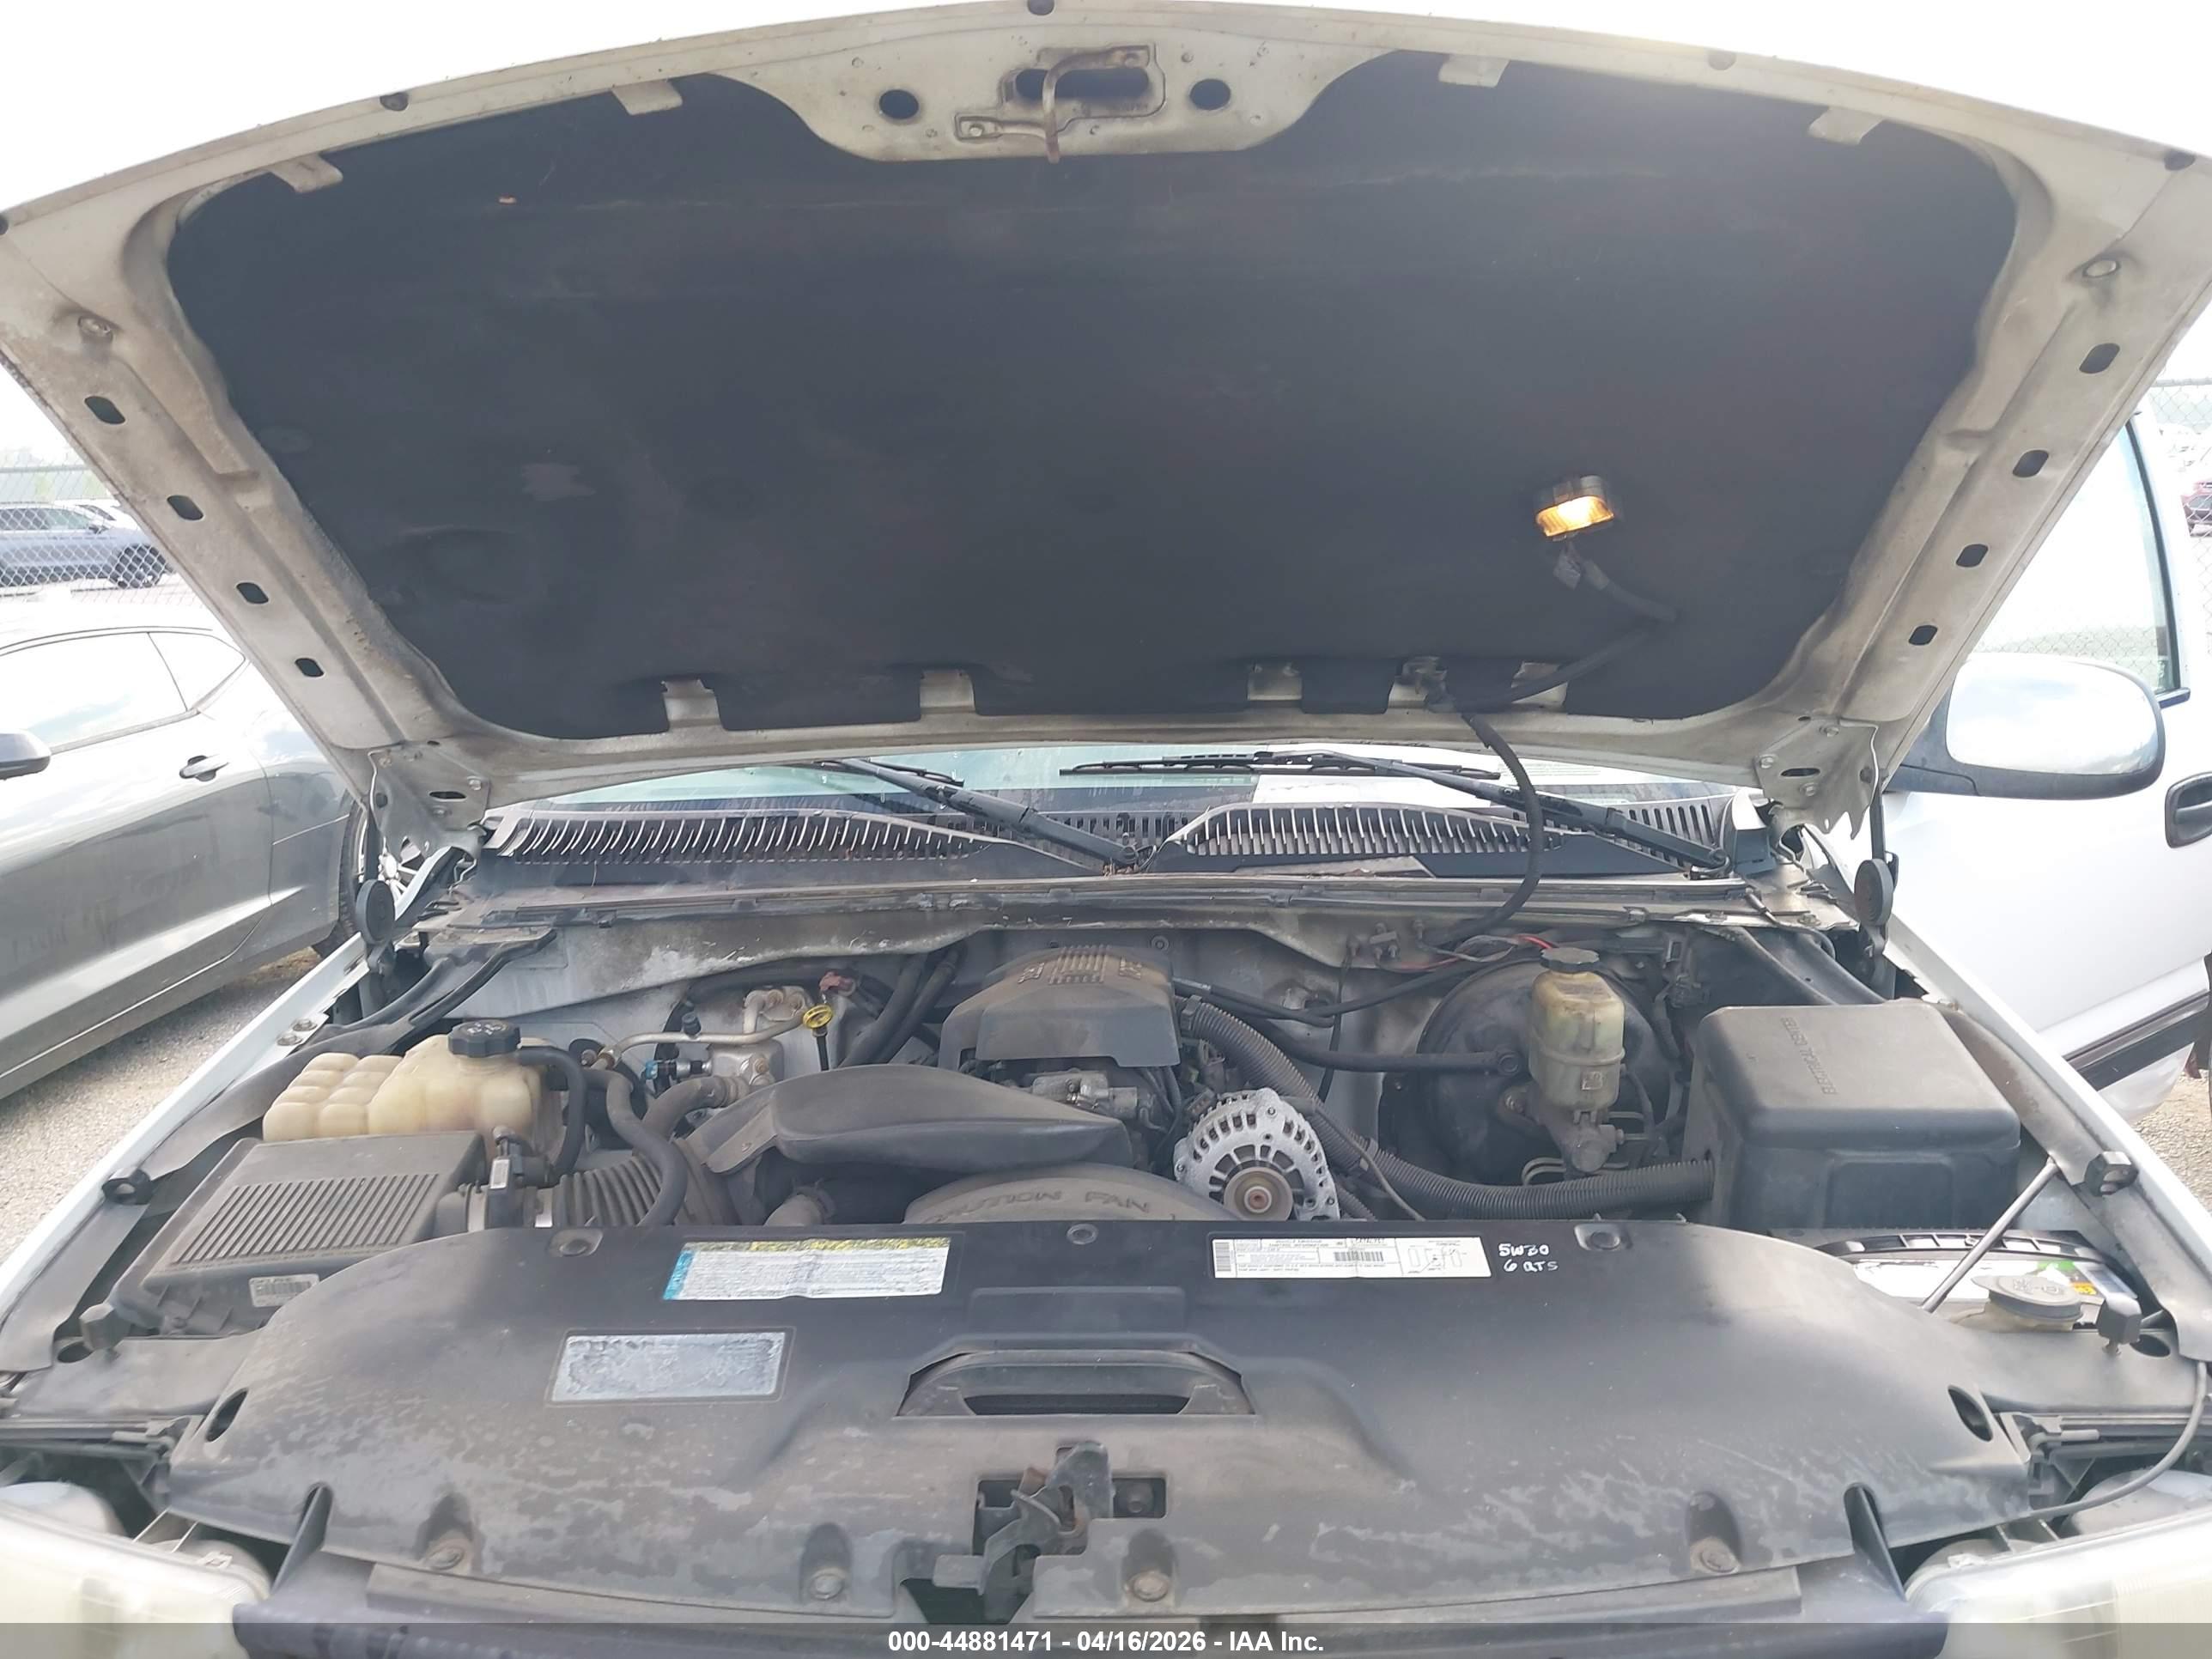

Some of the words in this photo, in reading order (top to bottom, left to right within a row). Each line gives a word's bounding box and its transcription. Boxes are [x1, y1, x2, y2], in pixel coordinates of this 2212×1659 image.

[1085, 1190, 1151, 1213] FAN
[1504, 1259, 1518, 1273] 6
[1522, 1261, 1559, 1273] QTS
